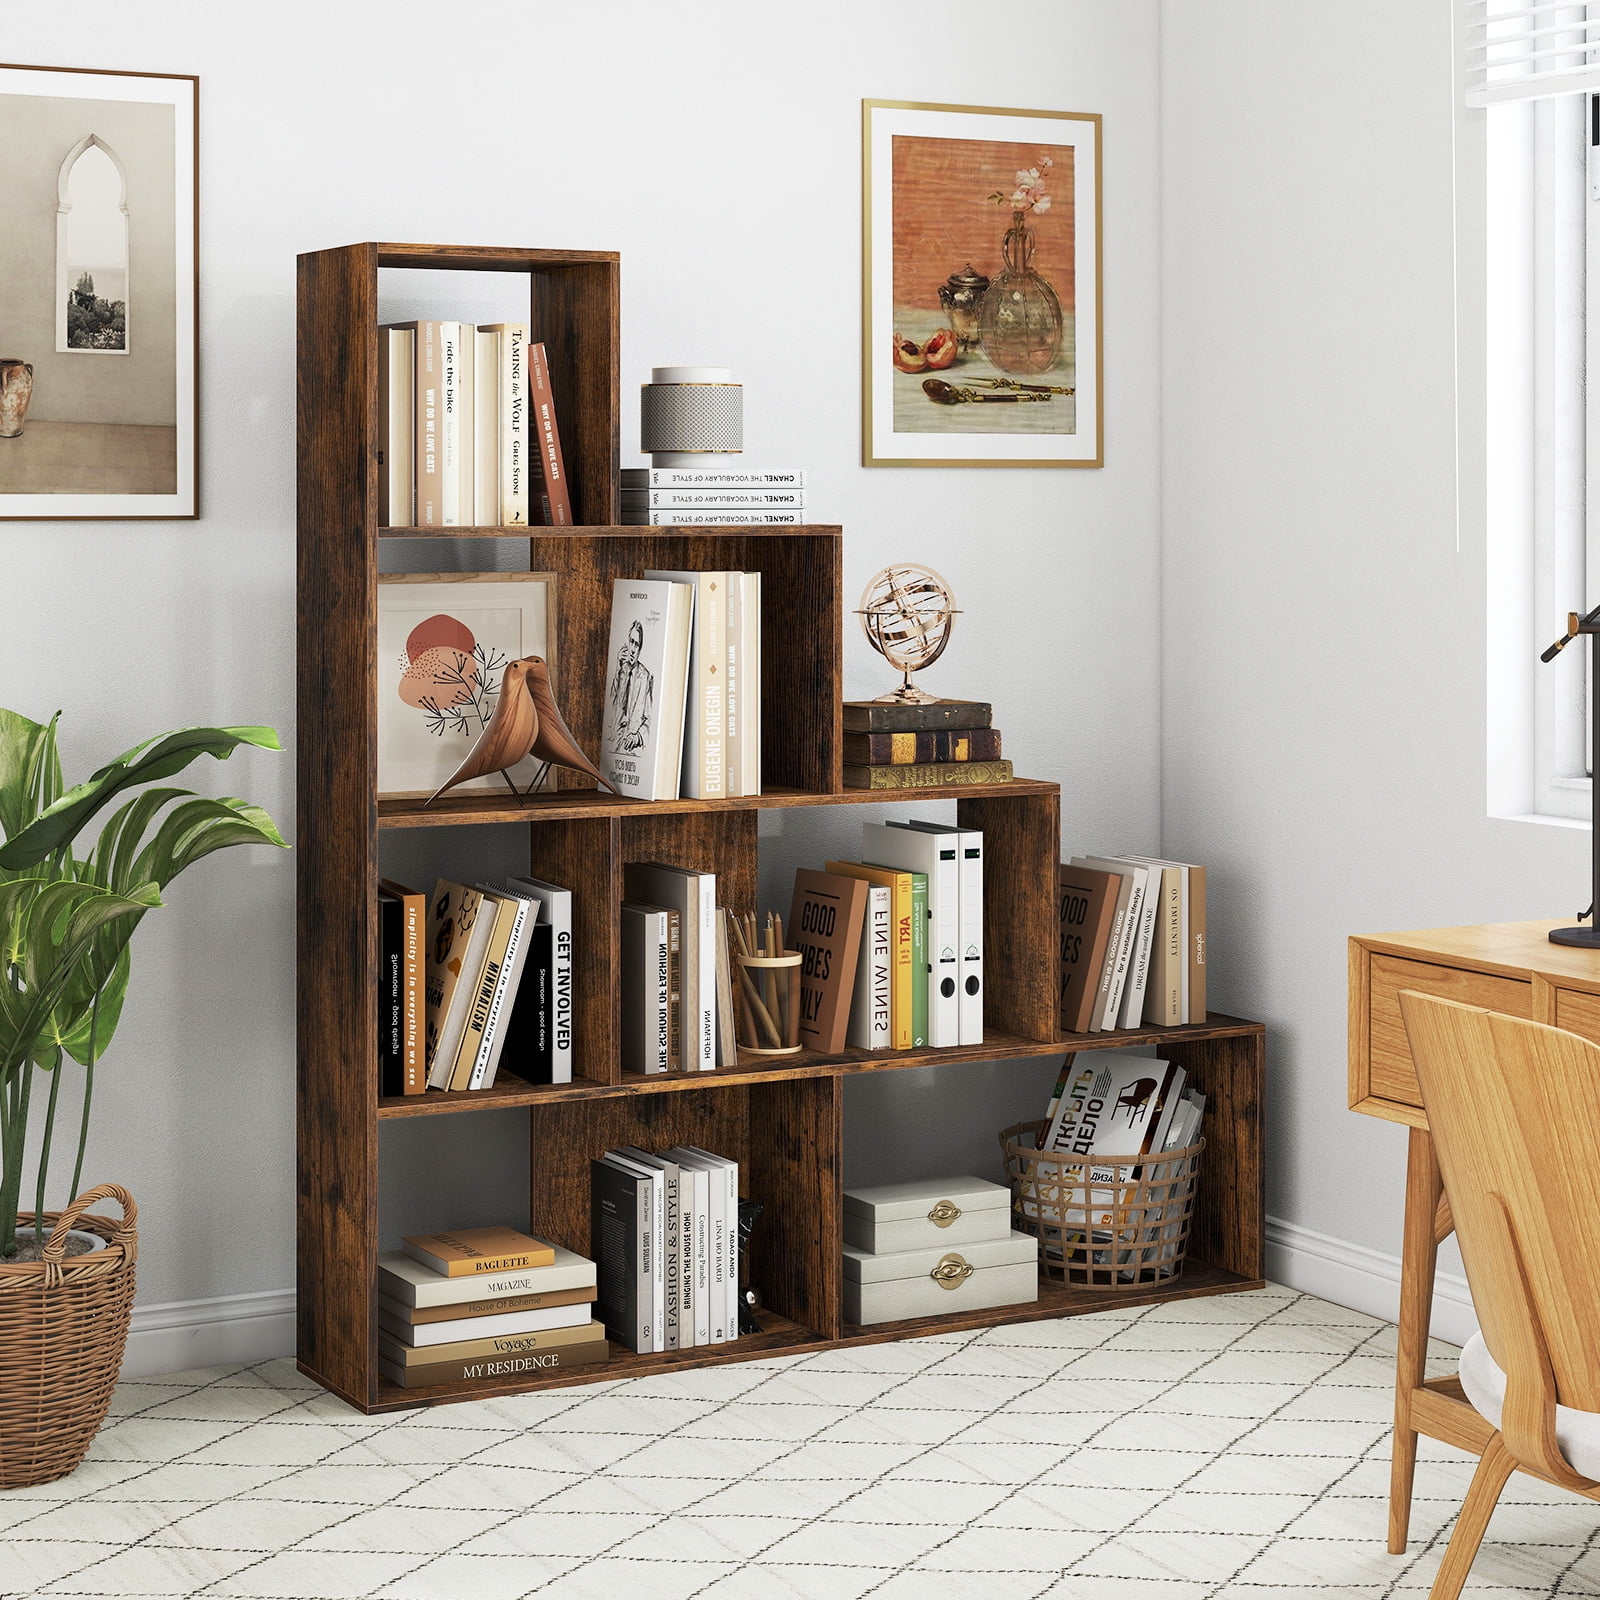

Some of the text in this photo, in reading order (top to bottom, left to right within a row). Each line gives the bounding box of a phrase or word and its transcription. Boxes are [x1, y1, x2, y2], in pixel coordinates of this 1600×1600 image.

[446, 341, 454, 413] ride the bike
[512, 330, 522, 432] TAMING the WOLF
[426, 389, 435, 473] WHY DO WE LOVE CATS
[541, 404, 560, 480] WHY DO WE LOVE CATS
[729, 667, 735, 677] DO
[729, 680, 735, 693] WE
[706, 686, 720, 793] EUGENE ONEGIN
[1061, 895, 1088, 925] OOD
[1171, 889, 1178, 901] ON
[801, 901, 836, 937] GOOD
[1115, 910, 1124, 933] GUIDE
[1118, 963, 1126, 973] for
[1123, 915, 1136, 953] sustainable
[1131, 887, 1141, 914] lifestyle
[507, 911, 525, 961] simplicity
[1110, 935, 1119, 958] GOOD
[1136, 960, 1144, 990] DREAM
[1144, 907, 1153, 936] AWAKE
[1196, 933, 1205, 964] spherical
[500, 976, 508, 986] in
[503, 965, 510, 974] is
[1102, 977, 1110, 992] THIS
[1105, 967, 1112, 975] IS
[408, 907, 416, 1086] simplicity is in everything we see
[471, 961, 500, 1033] MINIMALISM
[558, 931, 570, 1050] GET INVOLVED
[801, 988, 823, 1022] NLY
[485, 989, 503, 1044] everything
[480, 1046, 488, 1059] we
[1053, 1069, 1094, 1150] ТКРЫТЬ
[1072, 1099, 1104, 1155] ДЕЛО
[1091, 1173, 1126, 1184] ДИЗАН
[669, 1179, 677, 1327] FASHION & STYLE
[715, 1242, 722, 1254] BO
[476, 1257, 529, 1271] BAGUETTE
[488, 1279, 532, 1293] MAGAZINE
[468, 1297, 541, 1312] House Of Boheme
[494, 1337, 536, 1352] Voyage
[463, 1354, 559, 1379] MY RESIDENCE
